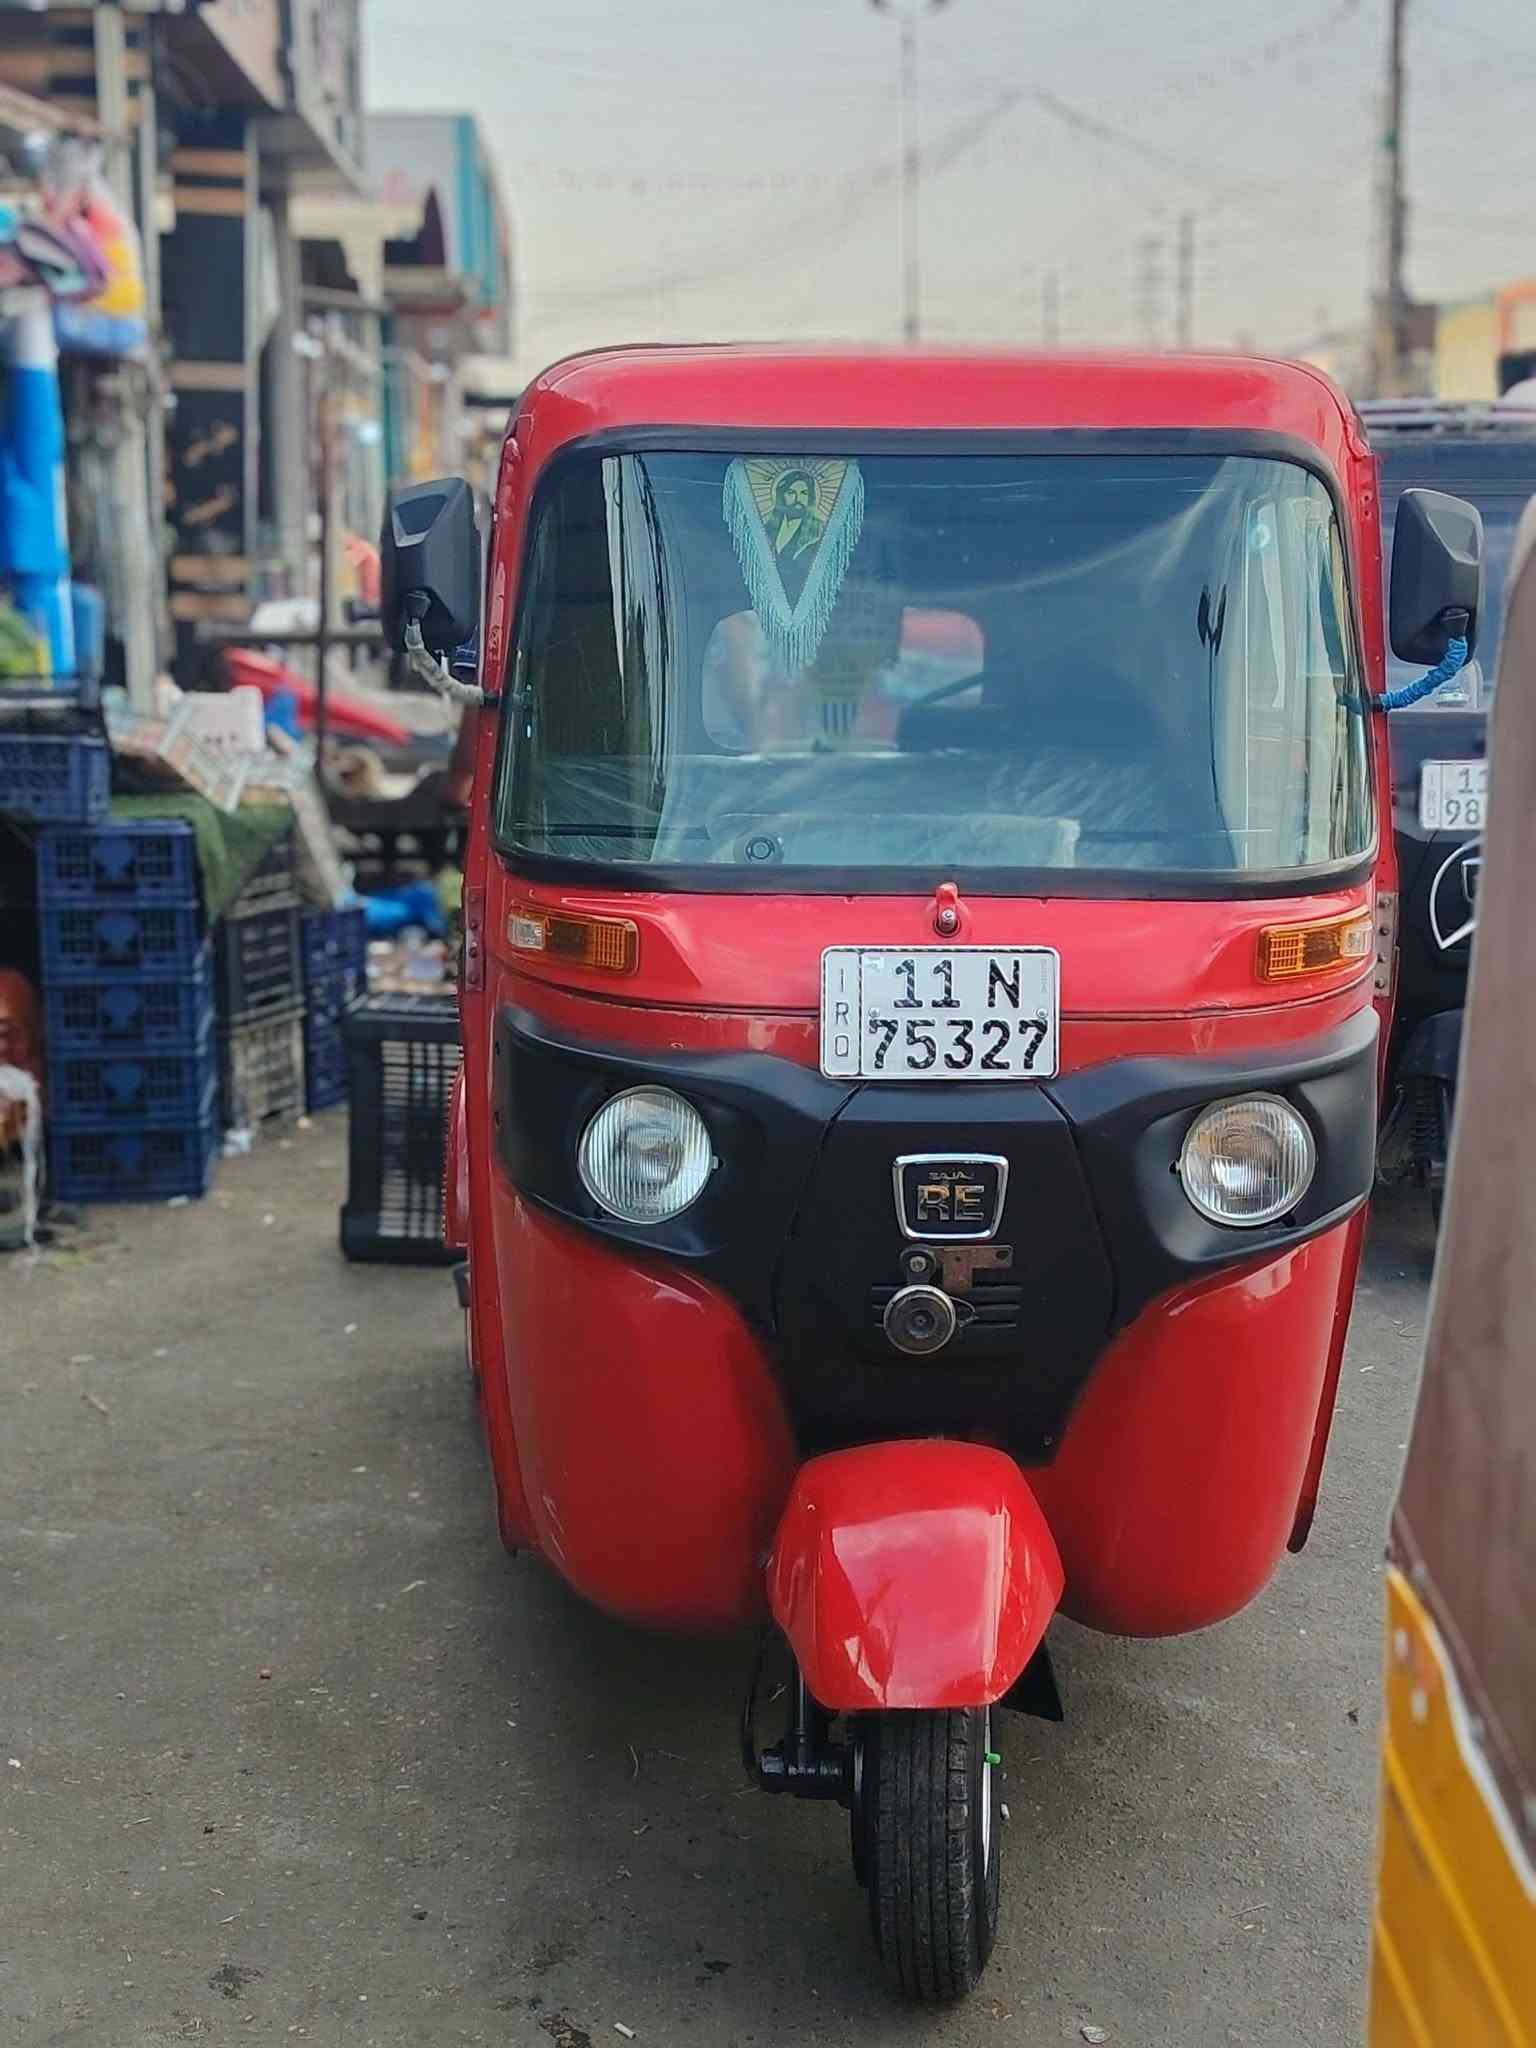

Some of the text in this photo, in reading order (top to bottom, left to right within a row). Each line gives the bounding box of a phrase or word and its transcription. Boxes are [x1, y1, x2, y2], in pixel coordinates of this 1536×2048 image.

[894, 959, 960, 1008] 11
[987, 959, 1019, 1008] N
[869, 1019, 1048, 1070] 75327
[917, 1184, 984, 1220] RE
